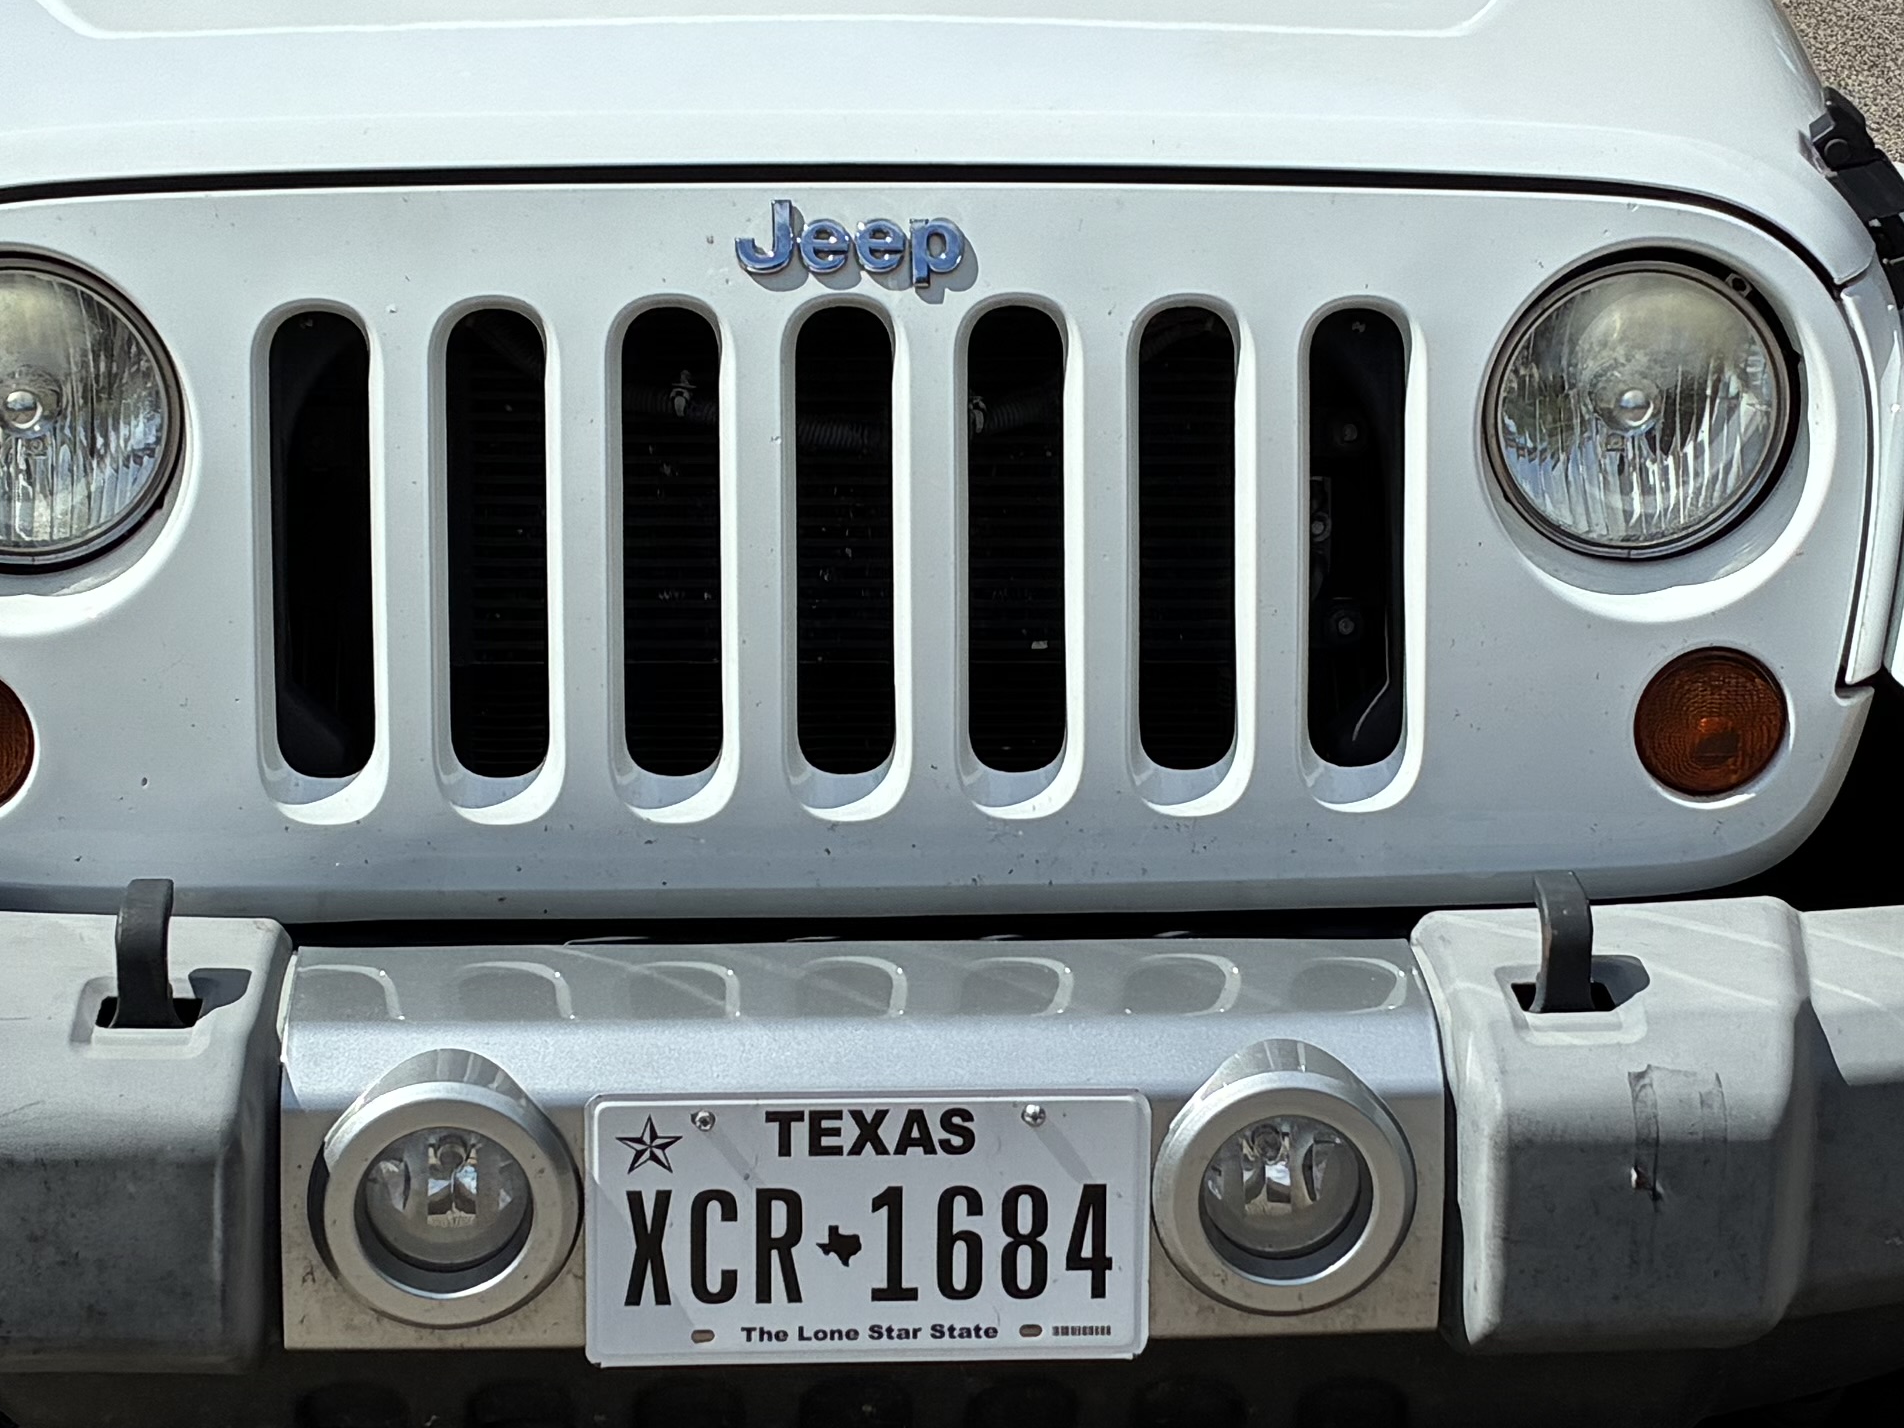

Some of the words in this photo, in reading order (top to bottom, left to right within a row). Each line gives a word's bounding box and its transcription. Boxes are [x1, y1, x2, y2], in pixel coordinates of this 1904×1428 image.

[734, 199, 965, 288] Jeep
[765, 1107, 976, 1158] TEXAS
[623, 1187, 804, 1307] XCR
[869, 1183, 1114, 1303] 1684
[741, 1327, 789, 1342] The
[798, 1325, 860, 1342] Lone
[868, 1324, 922, 1340] Star
[930, 1323, 999, 1339] State
